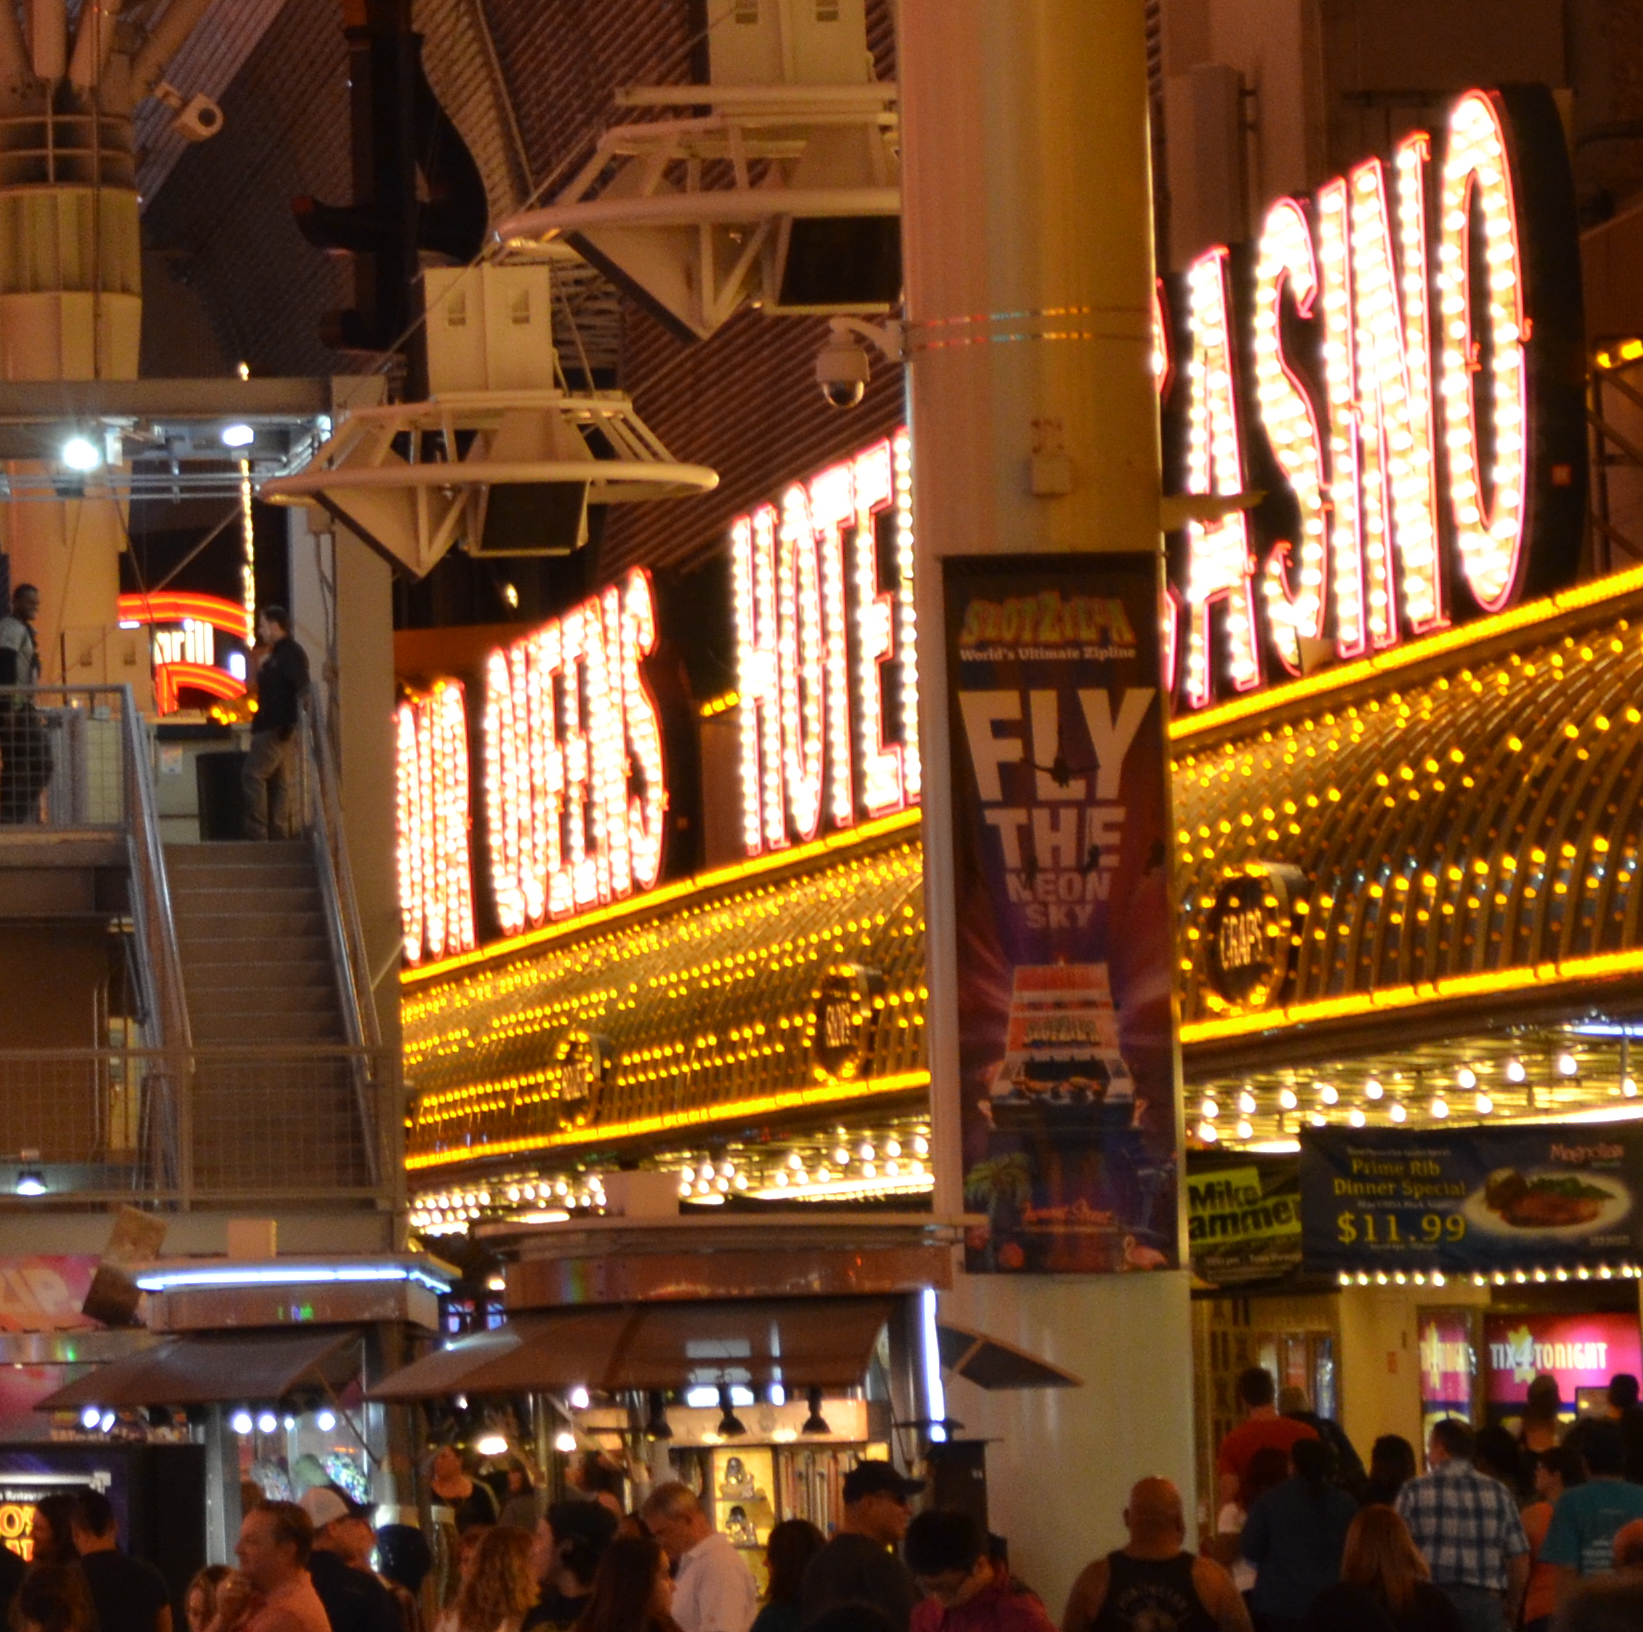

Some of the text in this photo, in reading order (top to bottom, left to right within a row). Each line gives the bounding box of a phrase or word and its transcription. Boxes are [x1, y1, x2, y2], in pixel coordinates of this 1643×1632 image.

[1155, 89, 1530, 708] ASINO
[960, 646, 1136, 663] World's Ultimate Zipline
[483, 568, 668, 935] QUEENS
[957, 688, 1156, 802] FLY
[983, 806, 1126, 867] THE
[1007, 872, 1111, 901] NEON
[1025, 903, 1095, 929] SKY
[1352, 1158, 1442, 1177] Prime Rib
[1188, 1179, 1259, 1211] Mike
[1333, 1177, 1466, 1199] Dinner Special
[1336, 1210, 1466, 1245] $11.99
[1489, 1342, 1515, 1370] TIX
[1533, 1341, 1608, 1370] TONIGHT
